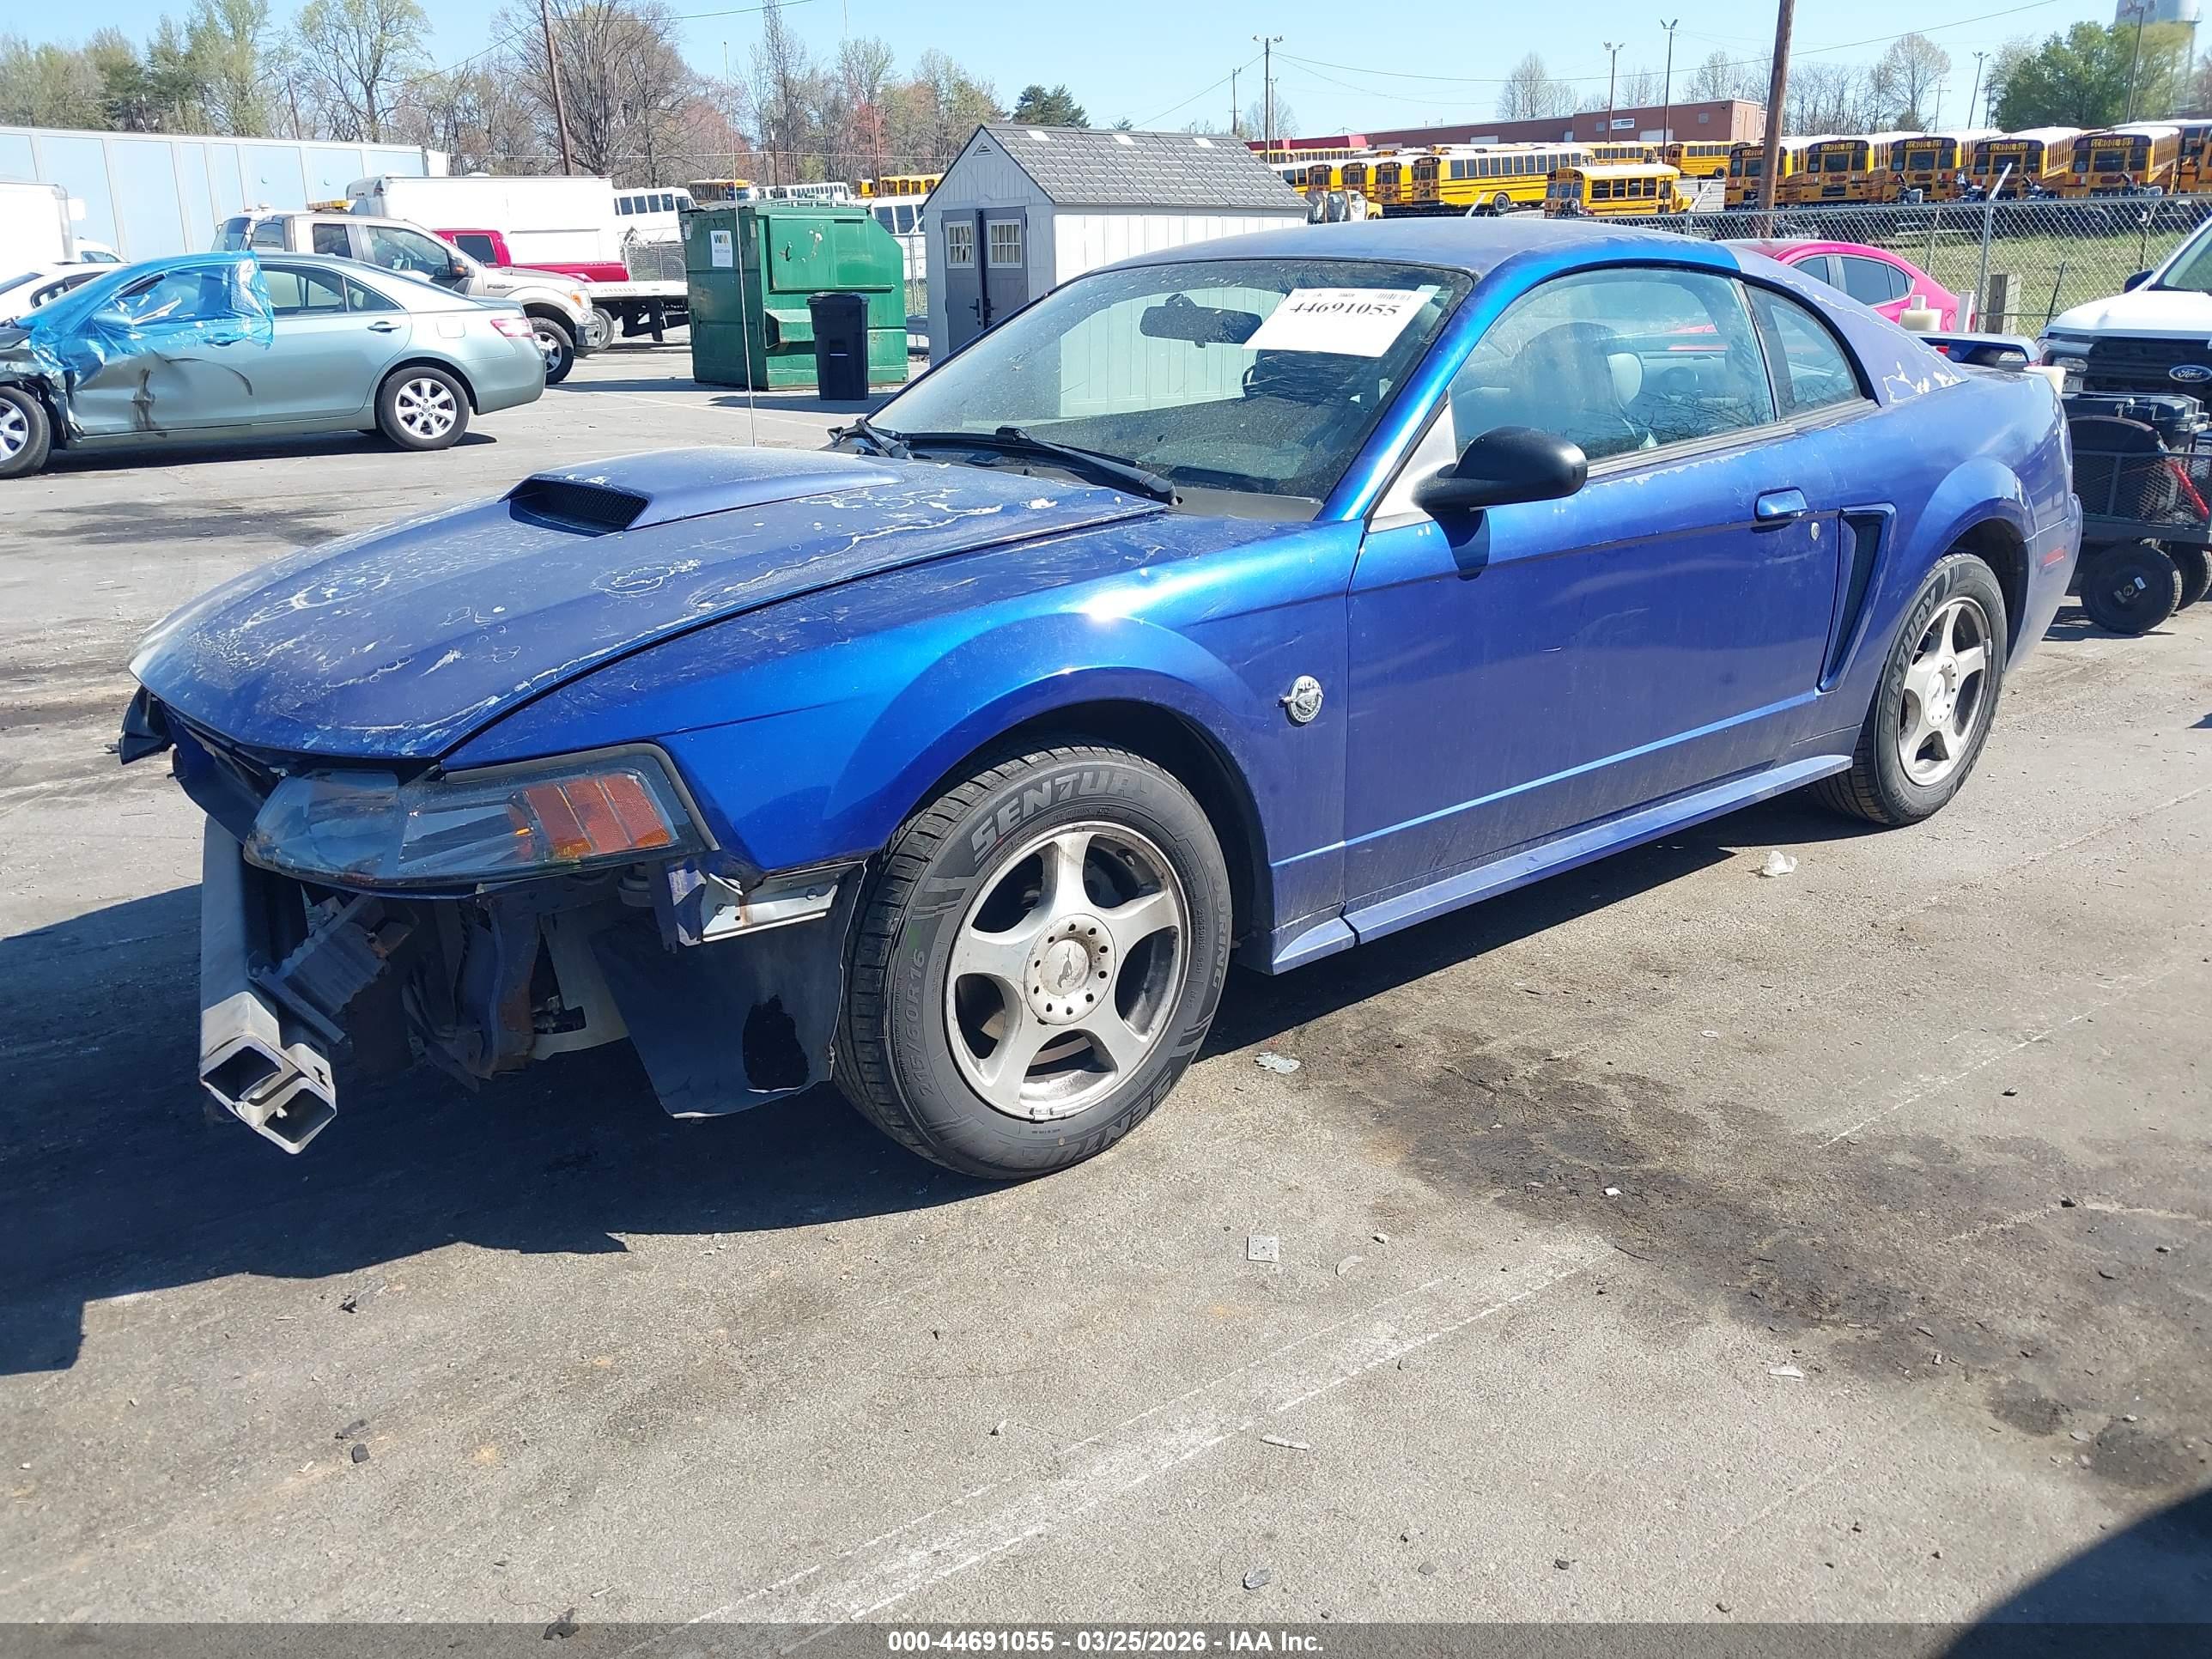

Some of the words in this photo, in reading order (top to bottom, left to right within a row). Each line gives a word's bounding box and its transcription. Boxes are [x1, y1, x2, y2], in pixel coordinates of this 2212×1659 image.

[1820, 143, 1841, 152] SCHOOL
[1844, 142, 1856, 150] BUS
[1905, 140, 1927, 149] SCHOOL
[1930, 139, 1942, 149] BUS
[1990, 143, 2012, 152] SCHOOL
[2016, 142, 2028, 151] BUS
[2091, 138, 2116, 148] SCHOOL
[2120, 137, 2135, 147] BUS
[714, 234, 730, 245] WM
[1289, 301, 1402, 317] 44691055
[970, 770, 1151, 851] SENTUR
[905, 948, 936, 1097] 215/60R16
